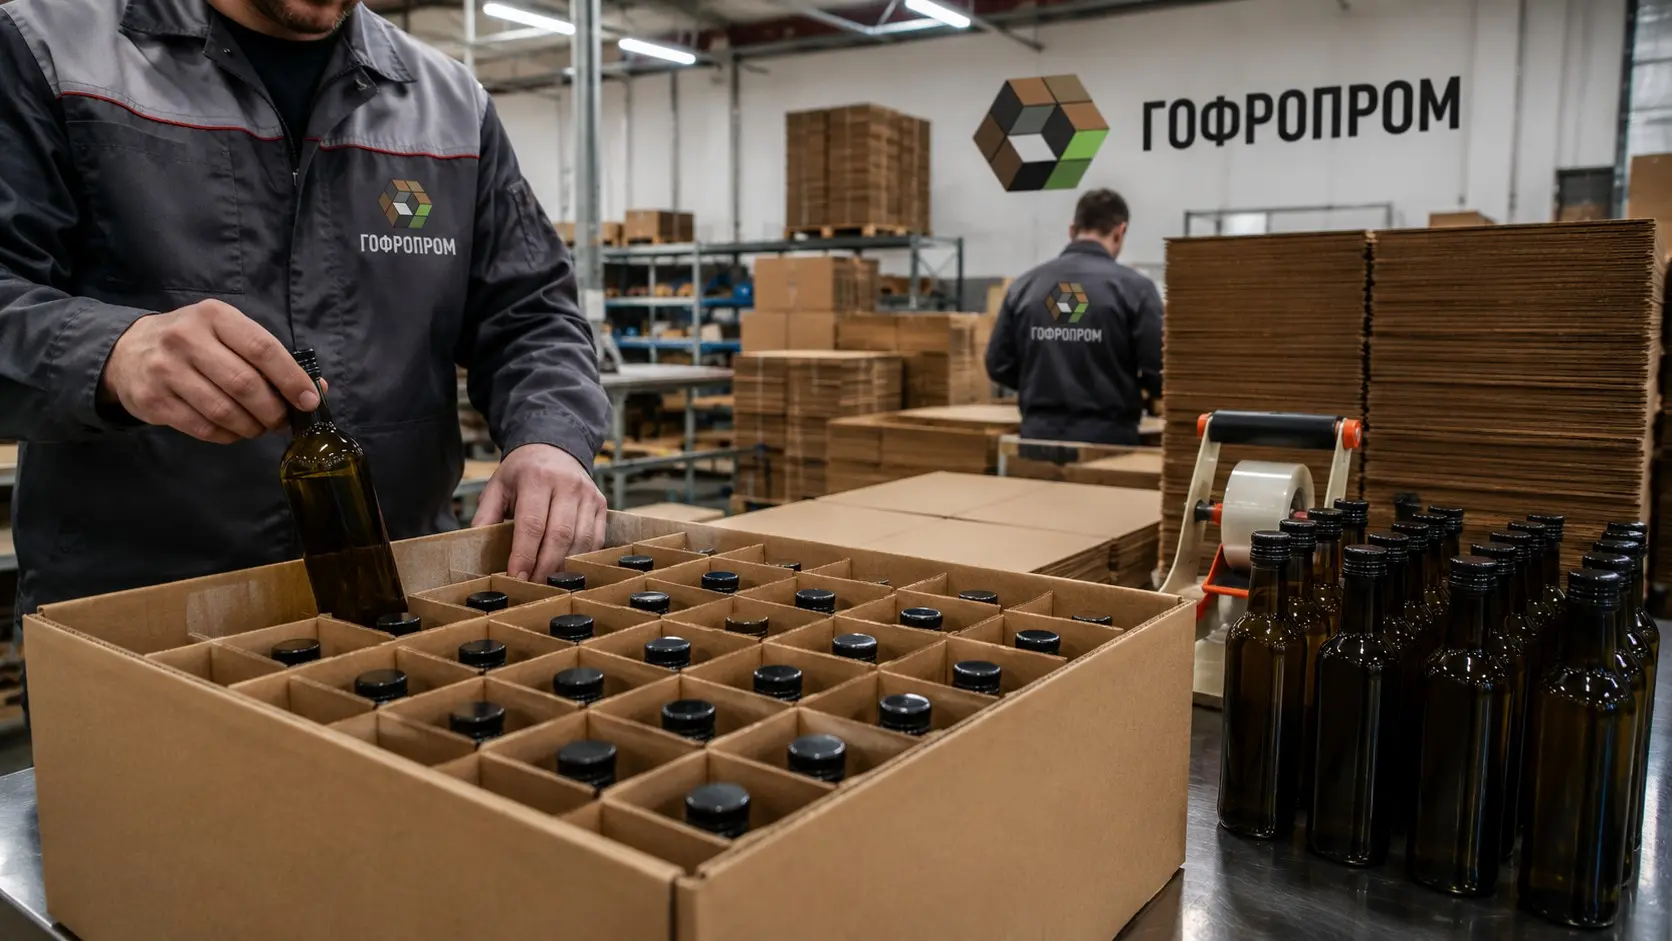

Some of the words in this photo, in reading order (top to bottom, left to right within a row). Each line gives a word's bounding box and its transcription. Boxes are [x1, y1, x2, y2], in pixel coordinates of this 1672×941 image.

[1143, 75, 1461, 151] ГОФРОПРОМ
[360, 233, 457, 256] ГОФРОПРОМ
[1031, 326, 1102, 343] ГОФРОПРОМ
